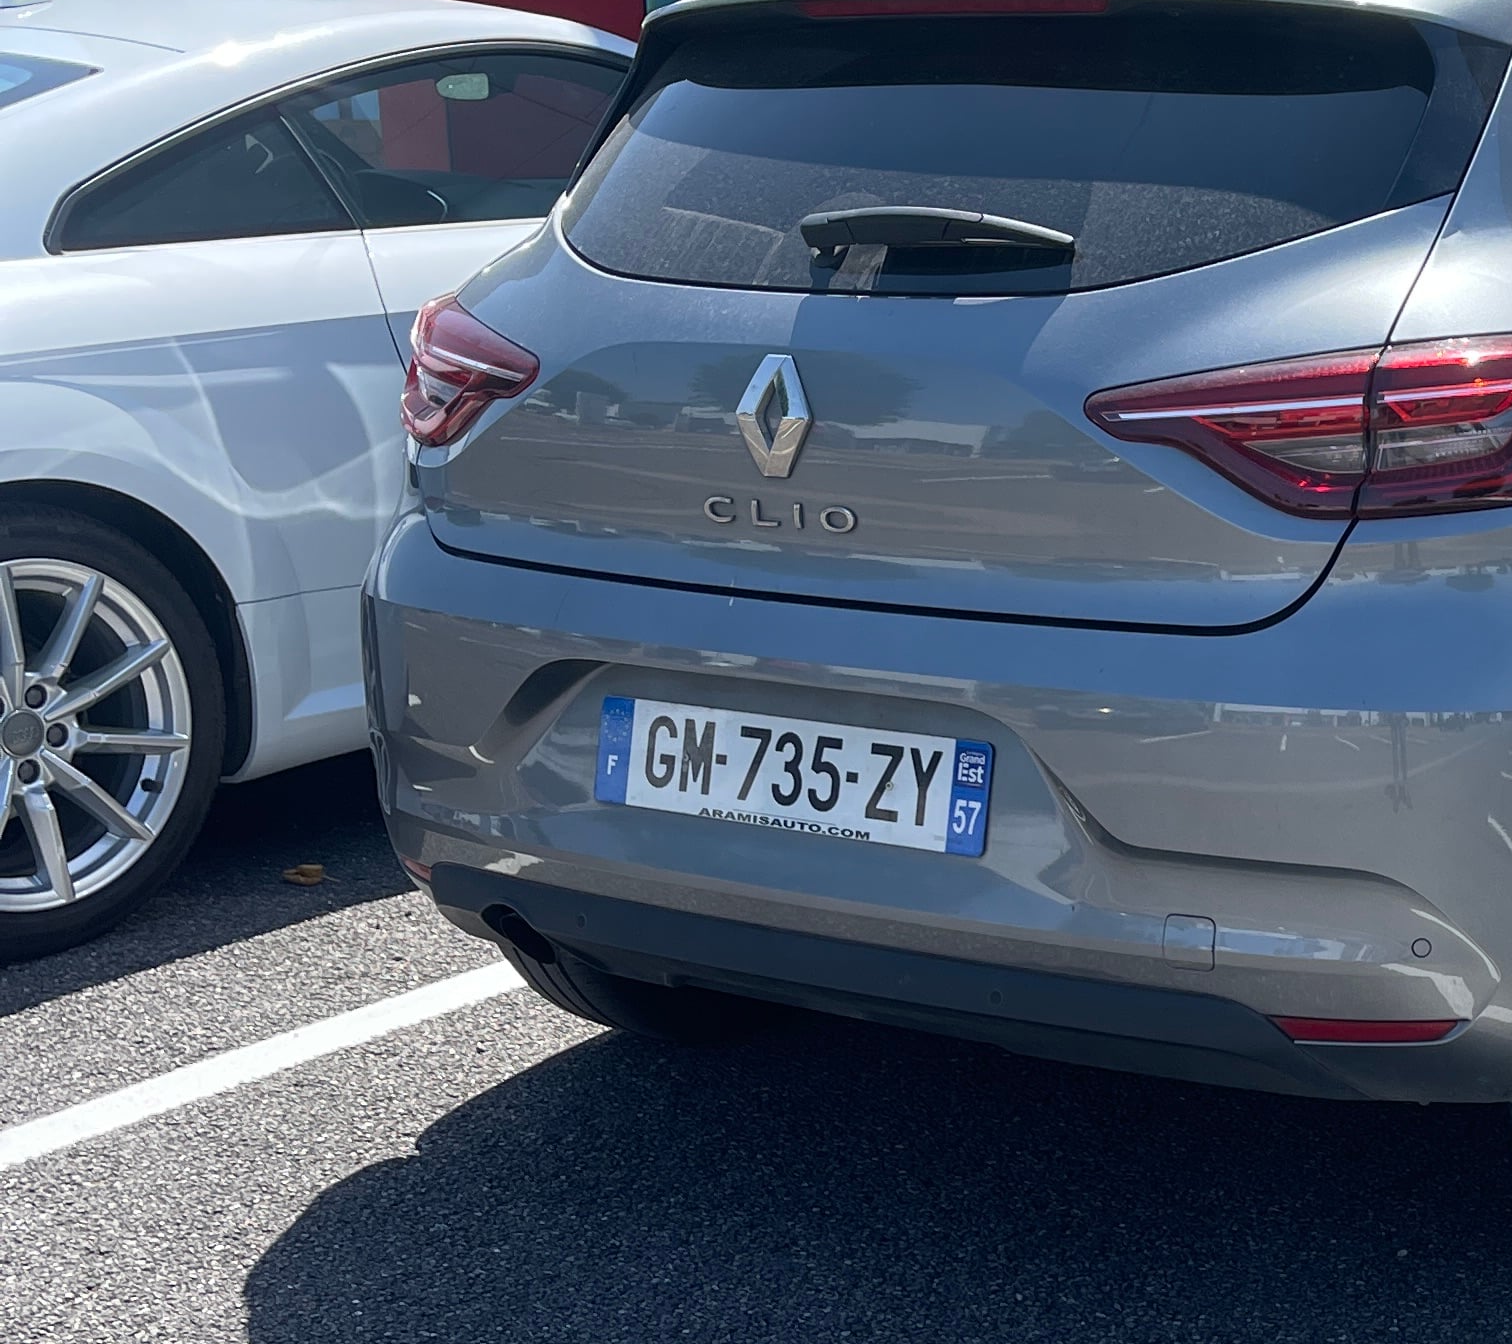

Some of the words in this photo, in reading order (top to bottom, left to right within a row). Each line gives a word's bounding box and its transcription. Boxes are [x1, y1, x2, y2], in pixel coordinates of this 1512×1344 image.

[704, 496, 858, 534] CLIO
[607, 754, 618, 776] F
[645, 715, 943, 827] GM-735-ZY
[957, 761, 985, 784] Est
[959, 751, 986, 765] Grand
[698, 807, 871, 841] ARAMISAUTO.COM
[952, 798, 982, 836] 57
